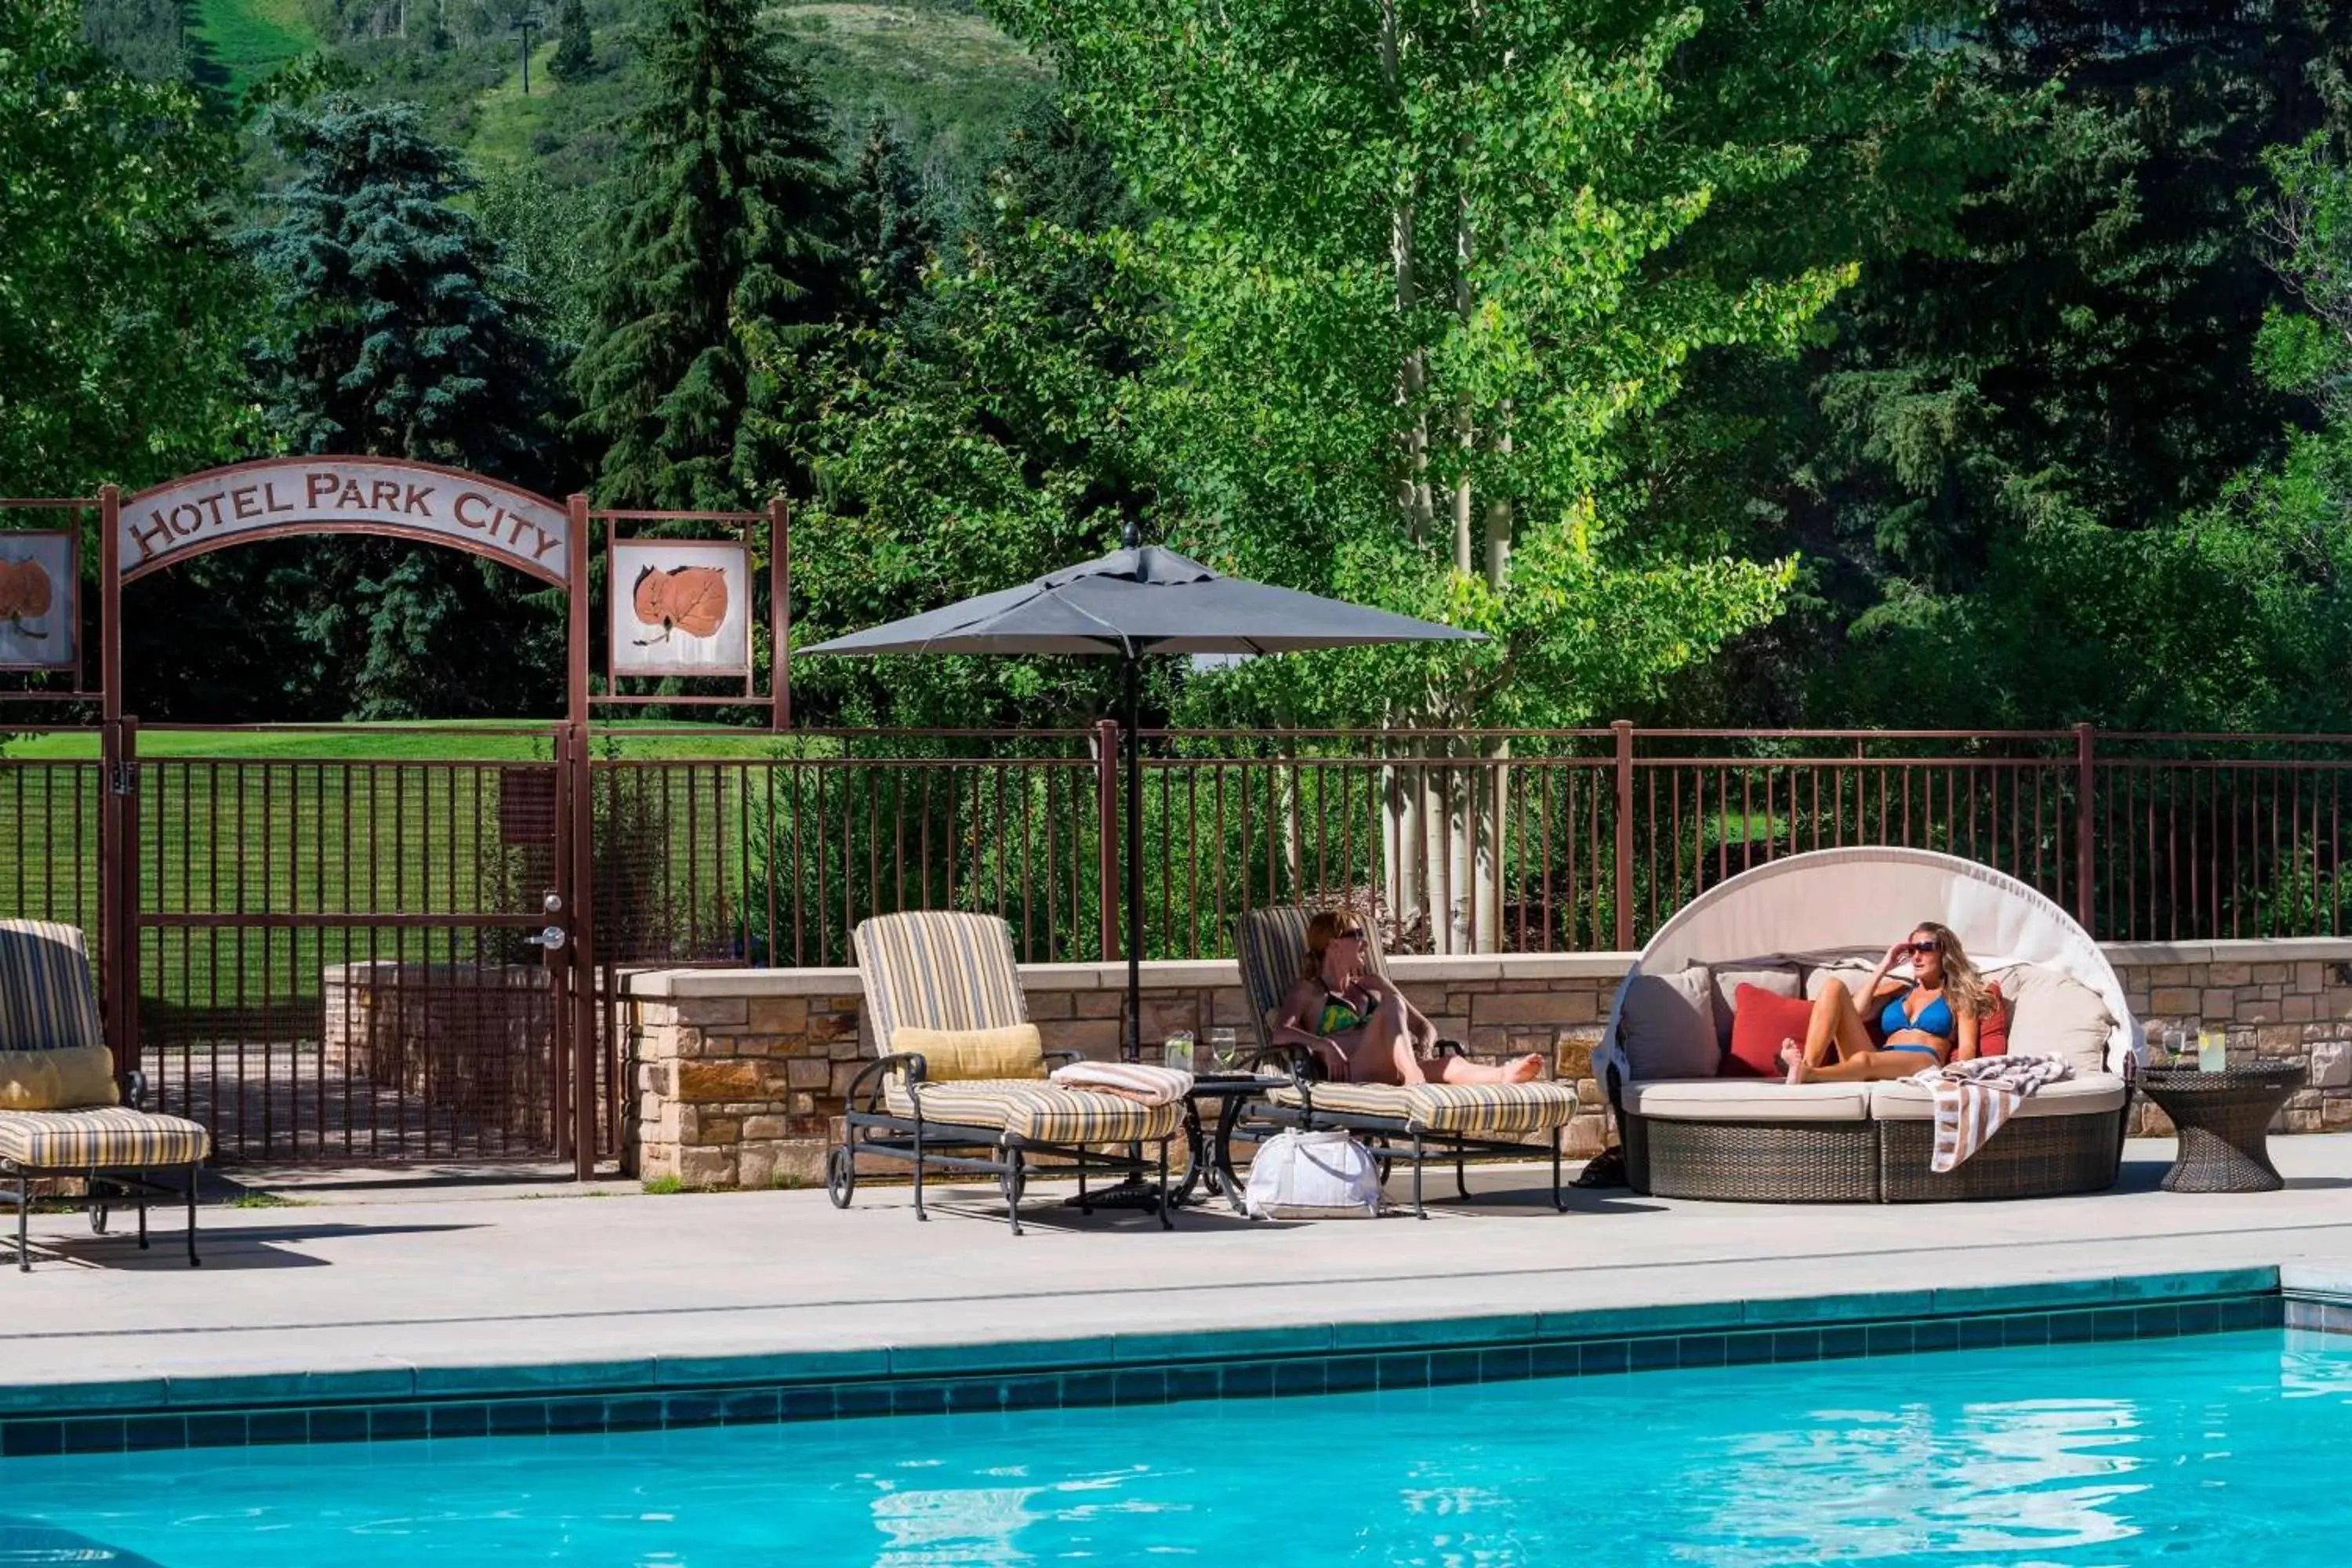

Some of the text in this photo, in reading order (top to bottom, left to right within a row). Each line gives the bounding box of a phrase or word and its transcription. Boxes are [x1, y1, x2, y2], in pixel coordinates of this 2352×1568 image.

[129, 473, 563, 561] HOTEL PARK CITY
